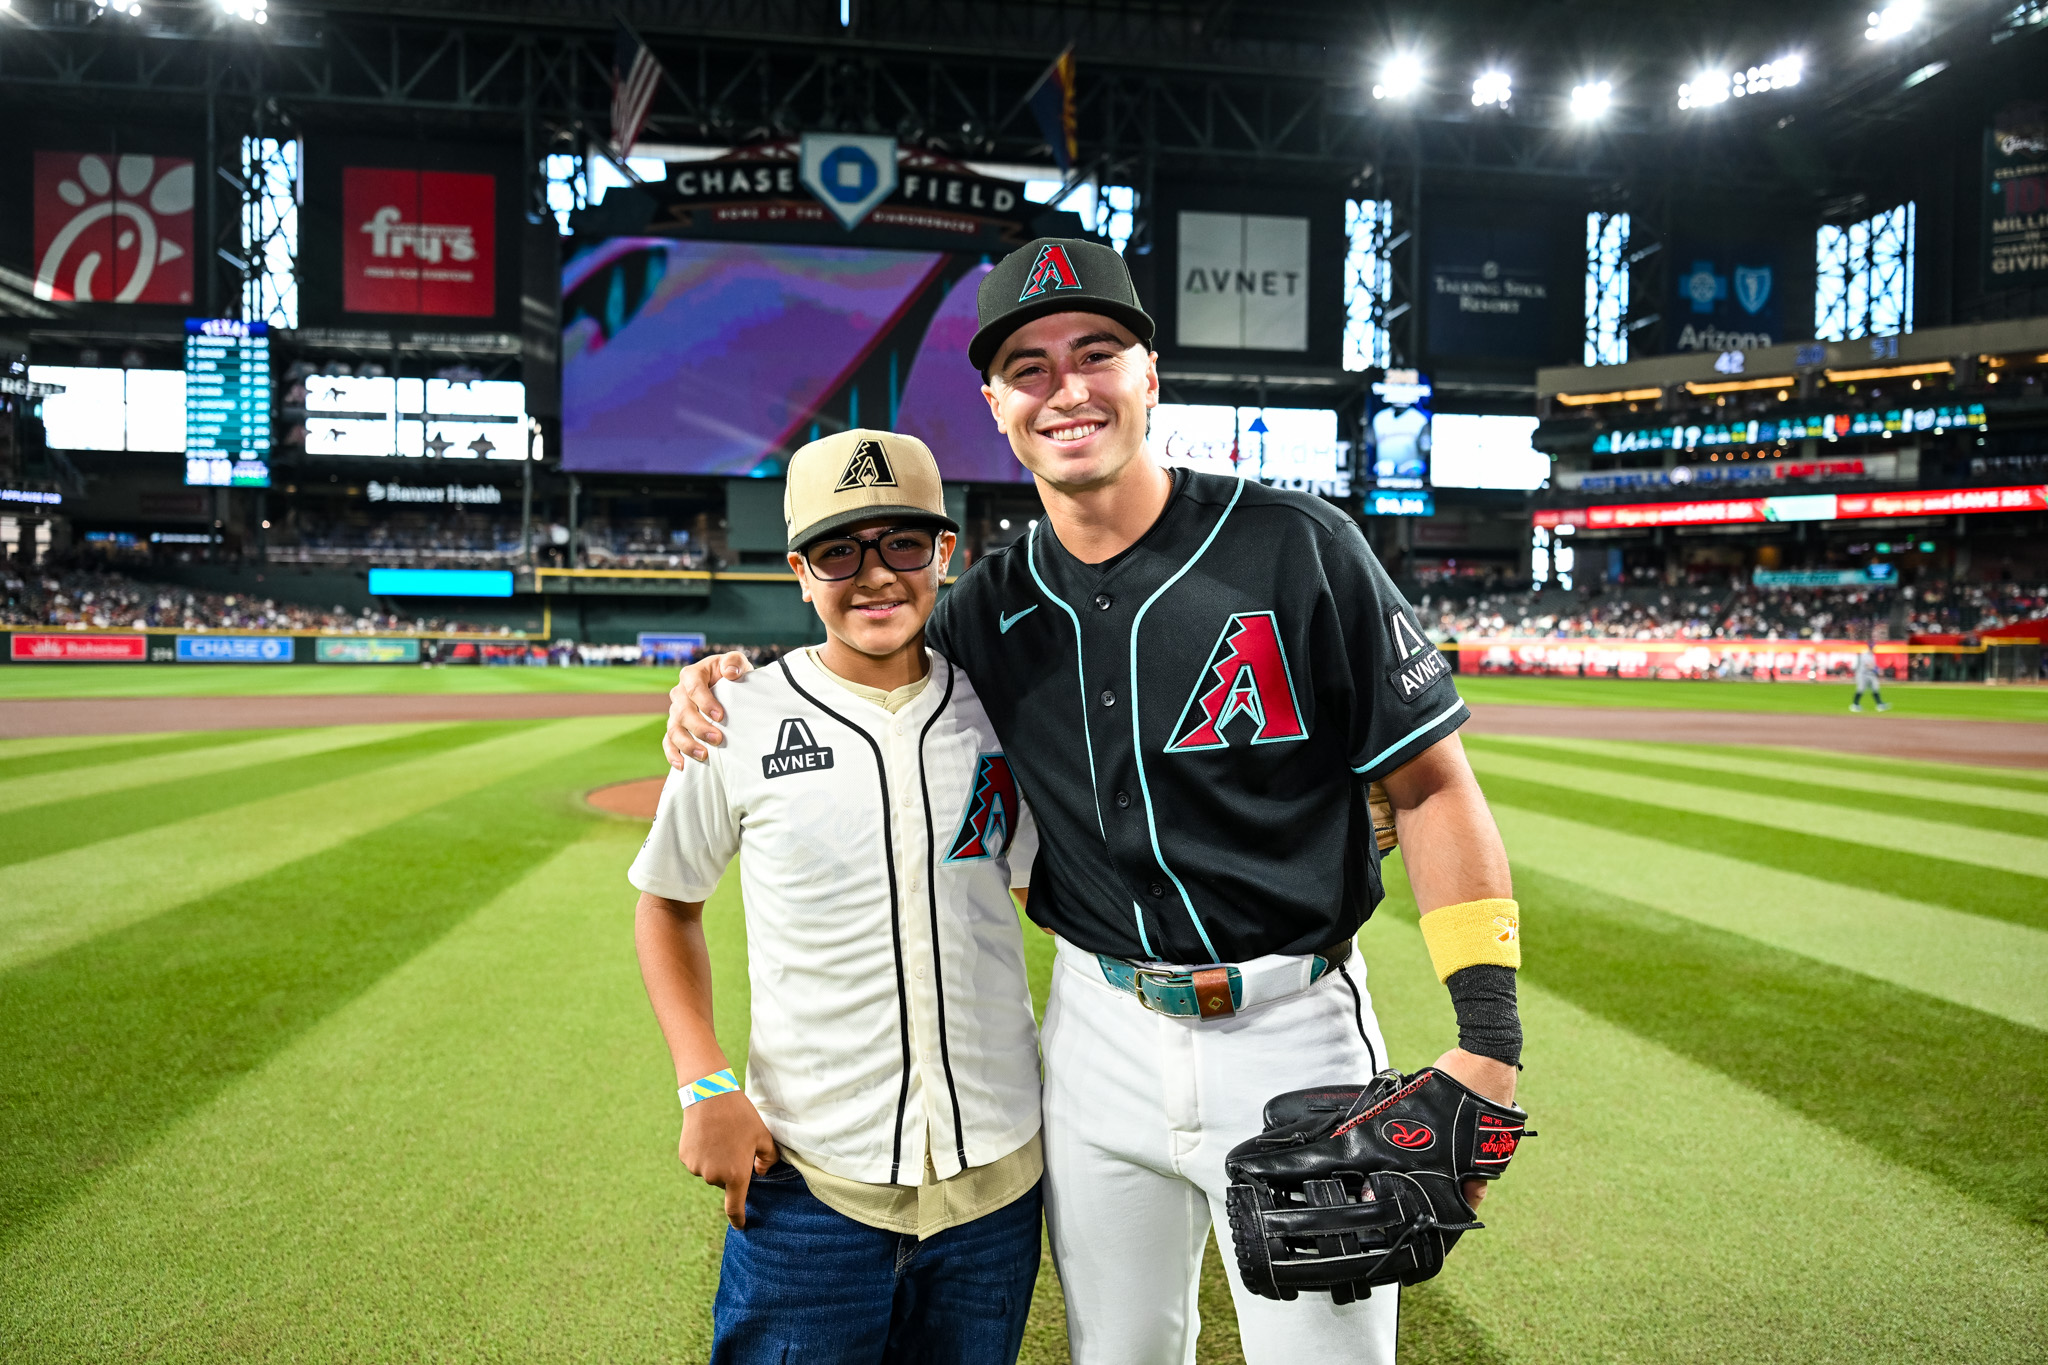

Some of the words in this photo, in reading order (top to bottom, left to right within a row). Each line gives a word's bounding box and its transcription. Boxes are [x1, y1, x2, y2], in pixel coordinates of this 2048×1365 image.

[676, 168, 794, 196] CHASE
[904, 175, 1016, 212] FIELD
[1185, 268, 1299, 297] AVNET
[387, 482, 444, 502] Banner
[447, 484, 502, 504] Health
[1951, 491, 1999, 509] SAVE
[190, 639, 260, 658] CHASE
[1400, 649, 1446, 696] AVNET
[768, 751, 828, 775] AVNET
